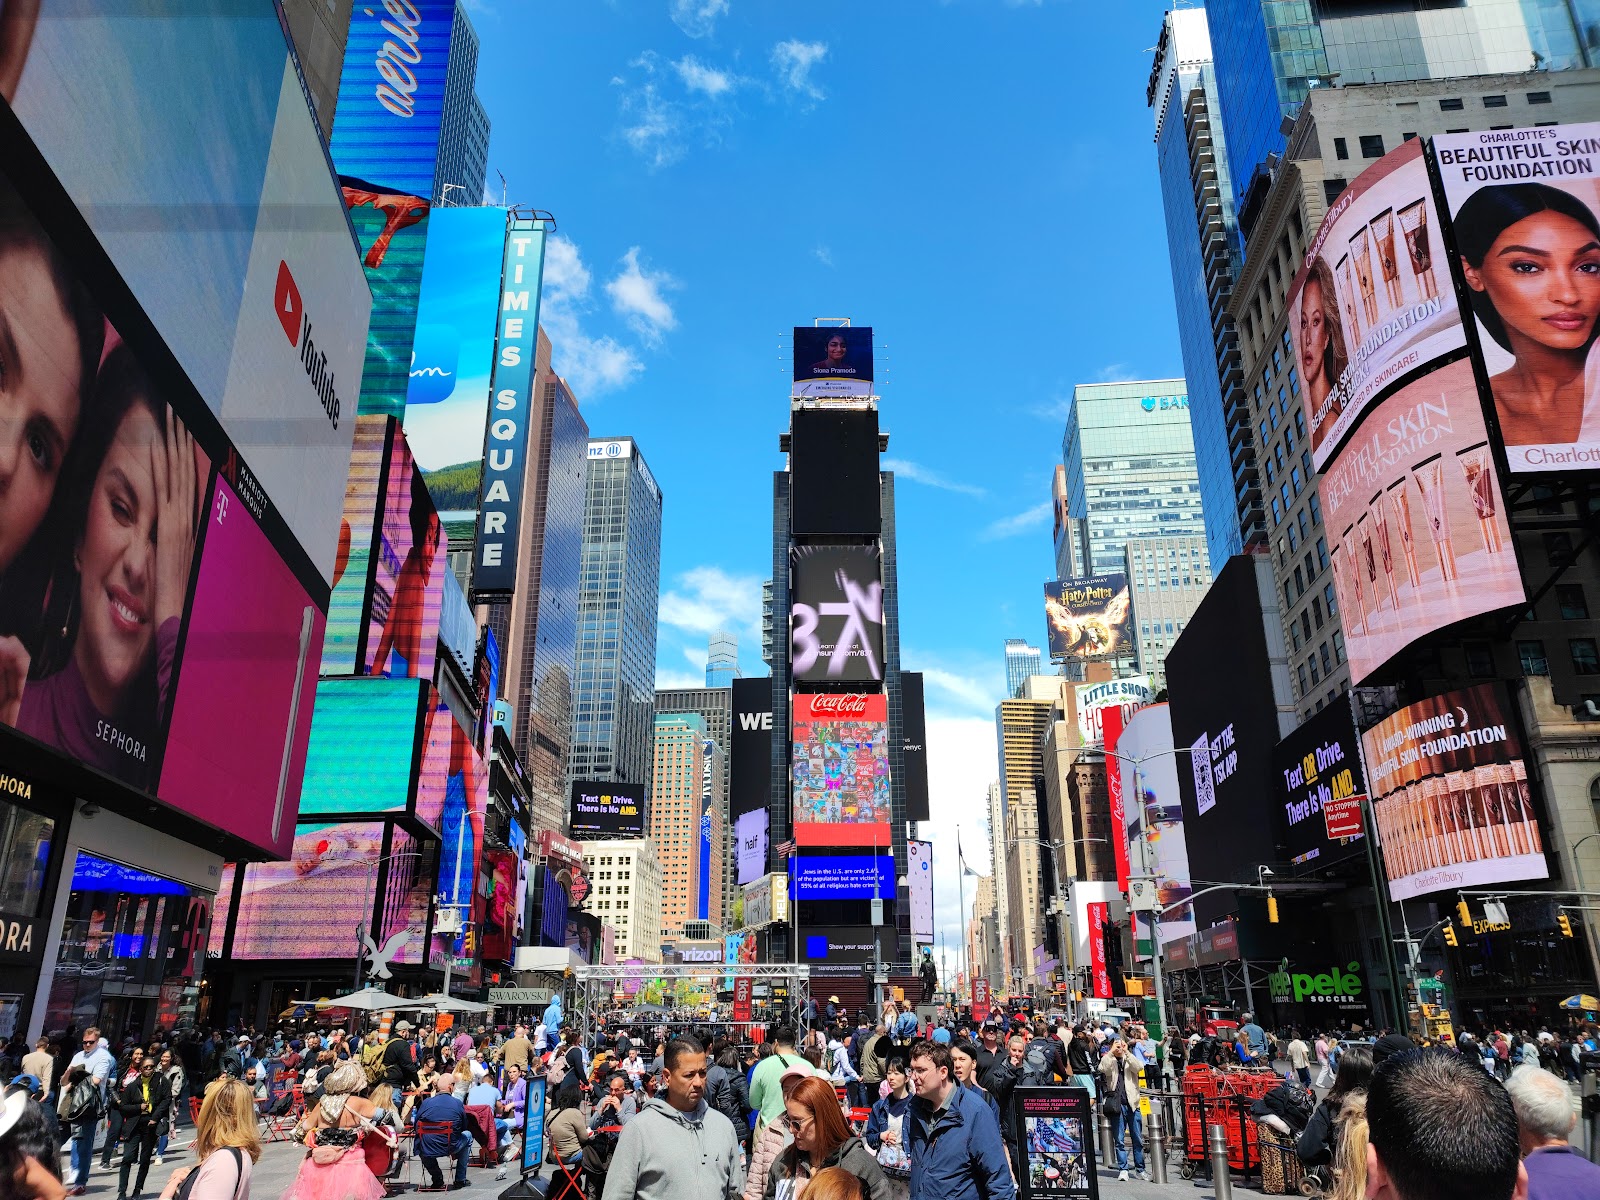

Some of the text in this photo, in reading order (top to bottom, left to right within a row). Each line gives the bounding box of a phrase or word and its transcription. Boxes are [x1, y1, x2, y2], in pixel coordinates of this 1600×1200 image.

[364, 0, 422, 118] aerie
[1480, 129, 1557, 144] CHARLOTTE'S
[1440, 138, 1600, 165] BEAUTIFUL SKIN
[1462, 158, 1593, 182] FOUNDATION
[500, 238, 531, 367] TIMES
[300, 312, 340, 431] YouTube
[1310, 297, 1442, 432] BEAUTIFUL SKIN FOUNDATION
[1365, 382, 1375, 396] BY
[1374, 351, 1420, 387] SKINCARE!
[1340, 394, 1348, 410] IS
[589, 447, 603, 456] nz
[1327, 392, 1450, 515] BEAUTIFUL SKIN
[1366, 419, 1454, 488] FOUNDATION
[240, 466, 268, 510] MARRIOTT
[482, 390, 518, 567] SQUARE
[237, 481, 262, 520] MARQUIS
[1075, 578, 1108, 586] BROADWAY
[1060, 586, 1112, 607] Harry Potter
[1083, 682, 1148, 706] LITTLE SHOP
[739, 712, 772, 731] WE
[1383, 713, 1455, 755] AWARD-WINNING
[96, 720, 146, 762] SEPHORA
[1221, 722, 1236, 750] THE
[1225, 749, 1238, 778] APP
[1284, 741, 1345, 792] Text OR Drive.
[1372, 725, 1506, 782] BEAUTIFUL SKIN FOUNDATION
[0, 773, 32, 800] HORA
[581, 794, 634, 804] Text OR Drive.
[1285, 768, 1357, 826] There Is No AND.
[577, 803, 639, 815] There Is No AND.
[1326, 800, 1360, 813] NO STOPPING
[1327, 811, 1350, 821] Anytime
[745, 835, 758, 851] half
[813, 875, 840, 883] population
[854, 868, 866, 876] only
[776, 876, 786, 919] HELLO!
[827, 882, 850, 890] religious
[738, 979, 749, 1002] tkts
[975, 981, 985, 1002] tkts
[1291, 960, 1361, 1002] pelé
[489, 991, 548, 1002] SWAROVSKI
